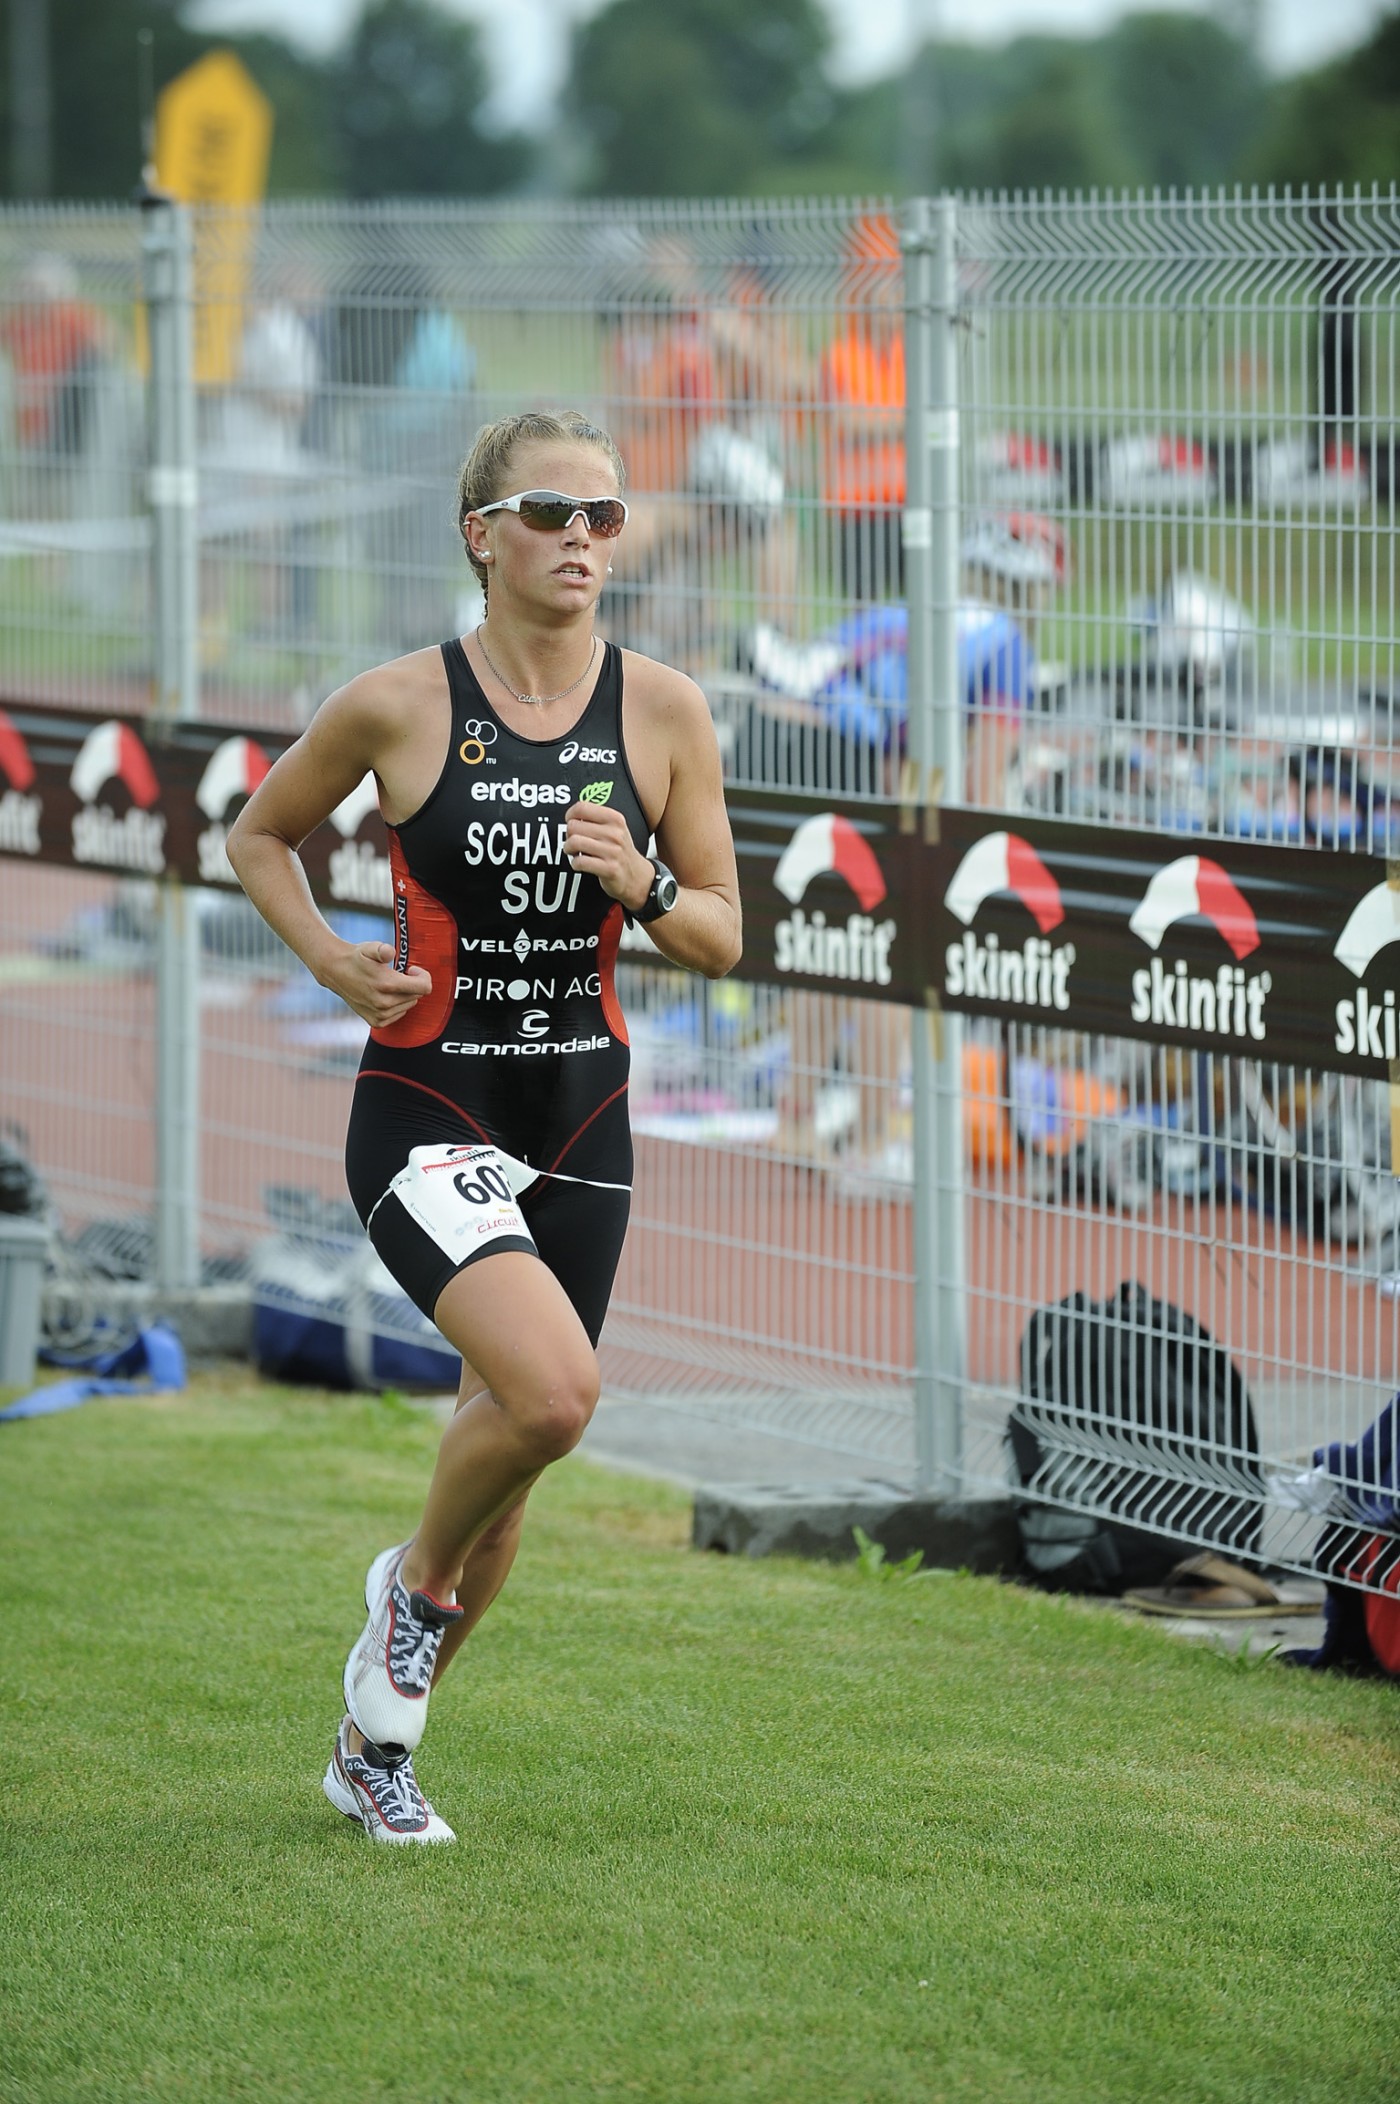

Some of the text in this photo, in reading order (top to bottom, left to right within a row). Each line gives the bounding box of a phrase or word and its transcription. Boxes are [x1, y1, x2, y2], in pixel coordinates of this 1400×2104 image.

[470, 778, 571, 807] erdgas
[464, 816, 575, 866] SCHÄR
[501, 870, 582, 914] SUI
[460, 934, 599, 955] VELORADO
[774, 908, 895, 986] skinfit
[454, 972, 602, 1001] PIRON AG
[945, 930, 1074, 1011] skinfit
[1131, 957, 1270, 1041] skinfit
[441, 1034, 611, 1056] cannondale
[453, 1164, 513, 1205] 60
